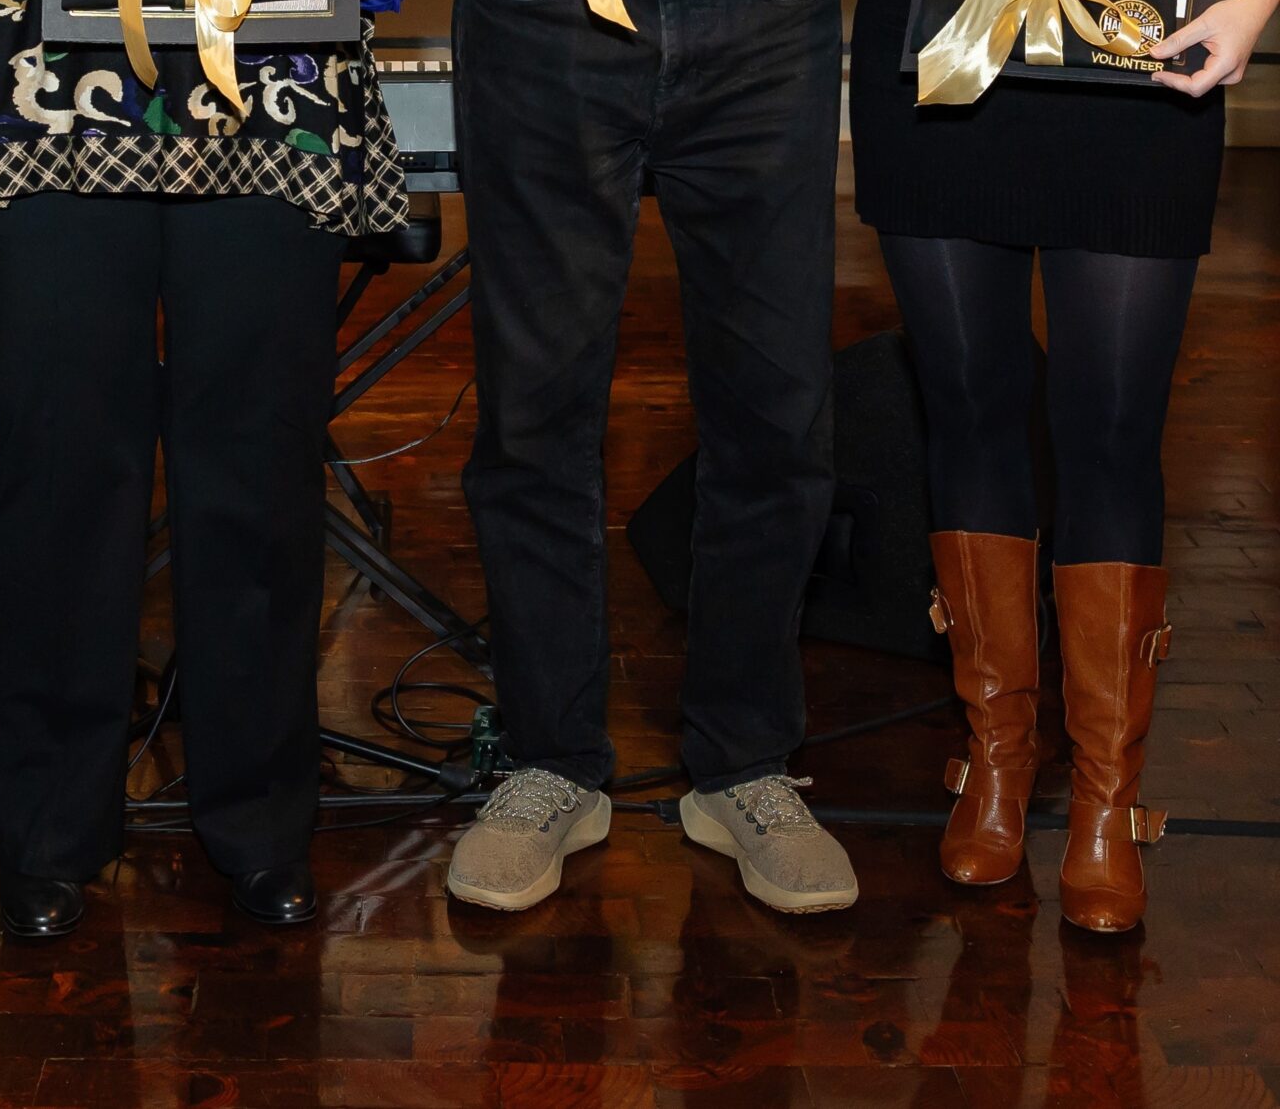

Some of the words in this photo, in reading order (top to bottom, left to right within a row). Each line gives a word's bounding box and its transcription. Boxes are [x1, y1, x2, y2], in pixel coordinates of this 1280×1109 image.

[1126, 9, 1150, 23] USIC
[1140, 25, 1162, 43] AME
[1091, 51, 1164, 71] VOLUNTEER
